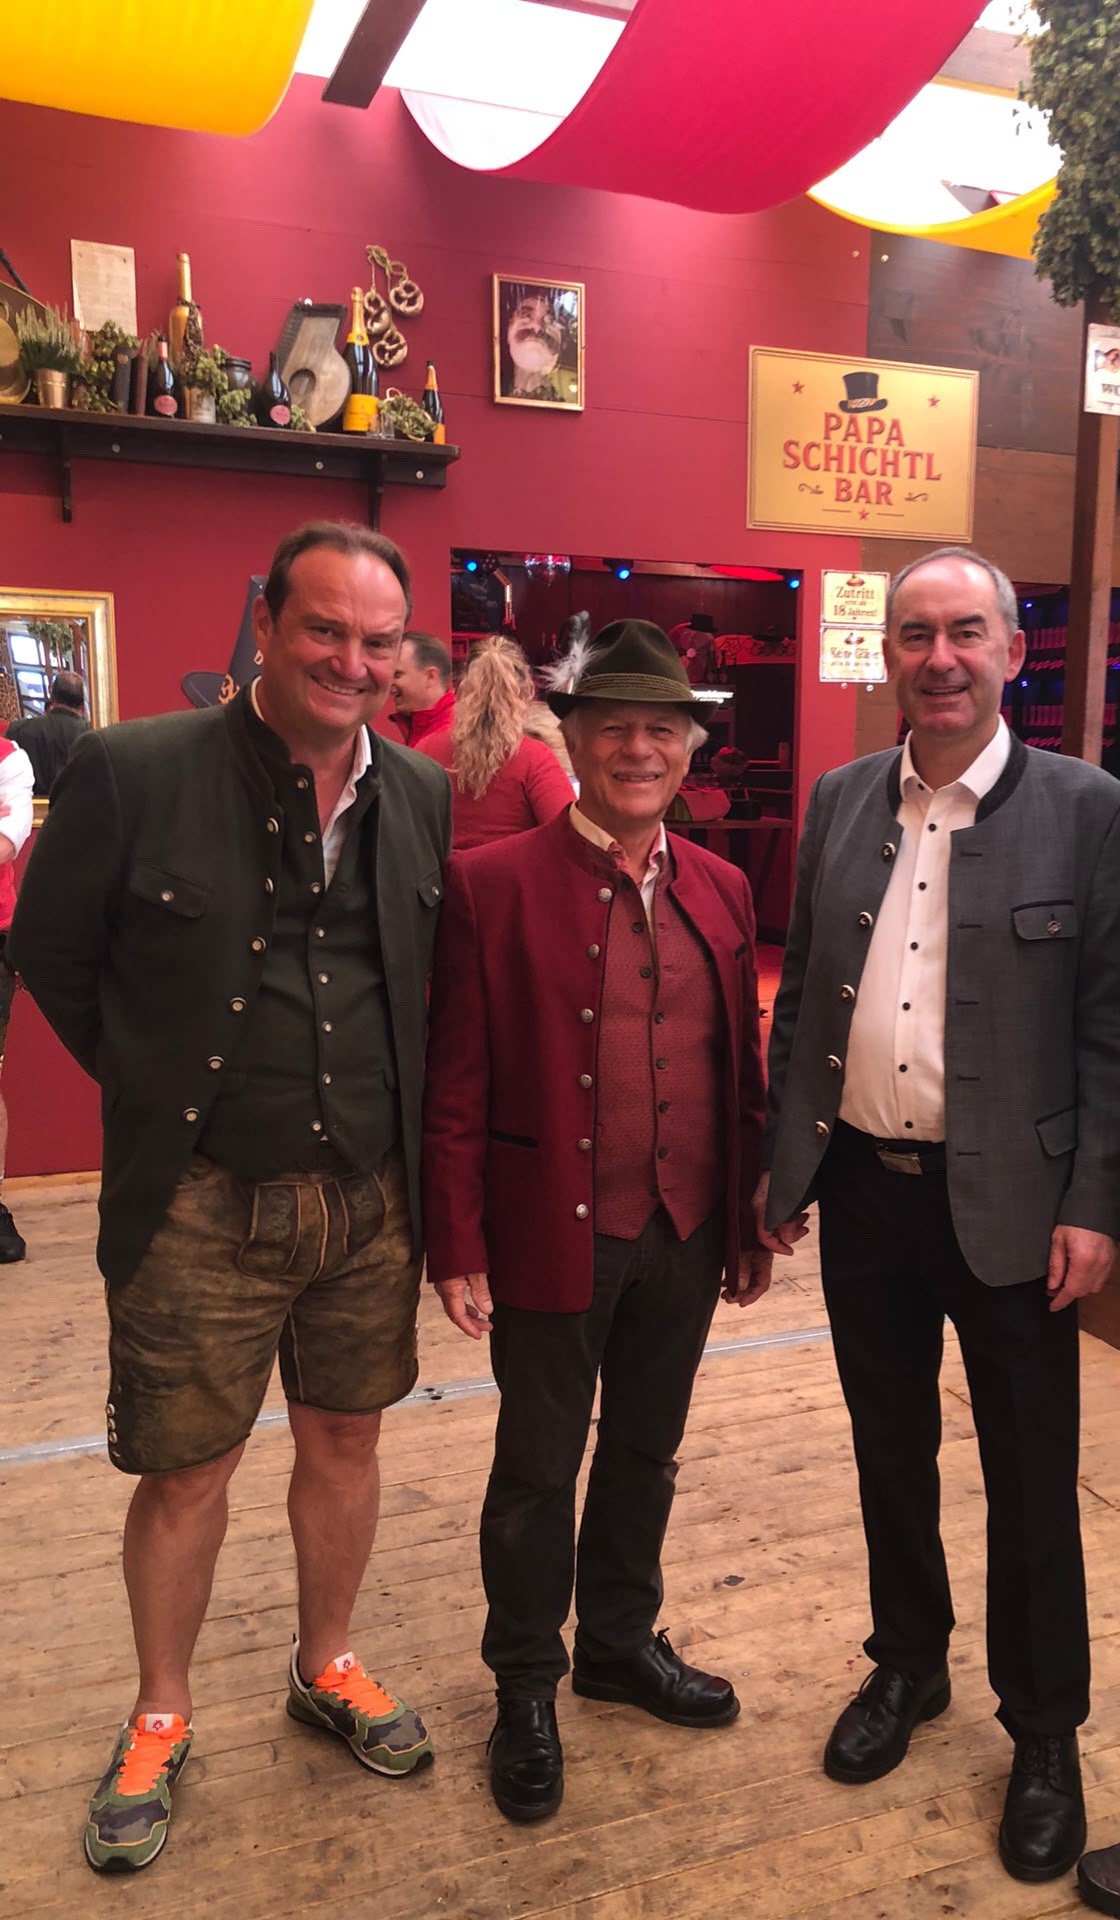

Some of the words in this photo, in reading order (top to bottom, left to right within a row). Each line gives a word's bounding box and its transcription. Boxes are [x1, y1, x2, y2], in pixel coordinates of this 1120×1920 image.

[823, 411, 906, 447] PAPA
[783, 439, 942, 481] SCHICHTL
[834, 477, 894, 506] BAR
[835, 586, 875, 600] Zutritt
[833, 604, 846, 616] 18
